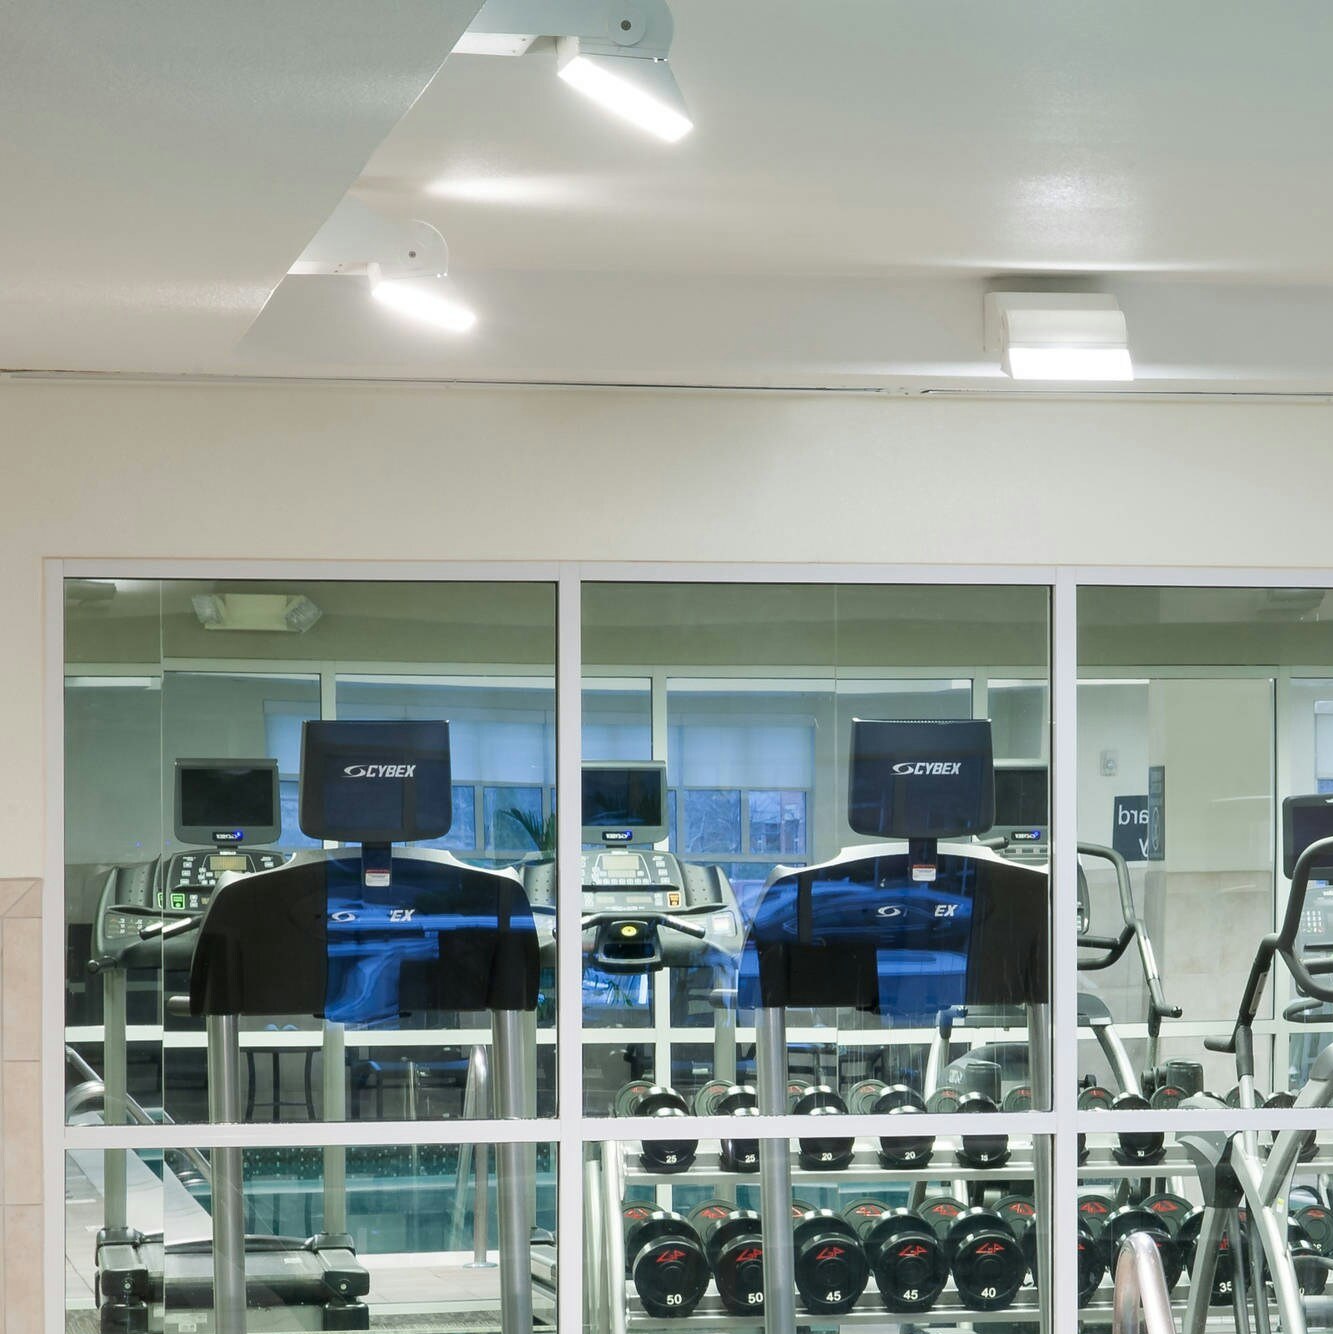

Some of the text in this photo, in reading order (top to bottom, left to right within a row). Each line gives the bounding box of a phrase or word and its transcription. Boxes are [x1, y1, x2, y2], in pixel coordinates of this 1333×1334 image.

[365, 764, 416, 778] CYBEX
[913, 762, 961, 775] CYBEX
[666, 1154, 677, 1163] 25
[745, 1154, 755, 1163] 25
[821, 1153, 832, 1161] 20
[904, 1152, 915, 1160] 20
[826, 1291, 842, 1302] 45
[903, 1289, 919, 1300] 45
[981, 1287, 996, 1298] 40
[666, 1294, 683, 1305] 50
[748, 1293, 764, 1304] 50
